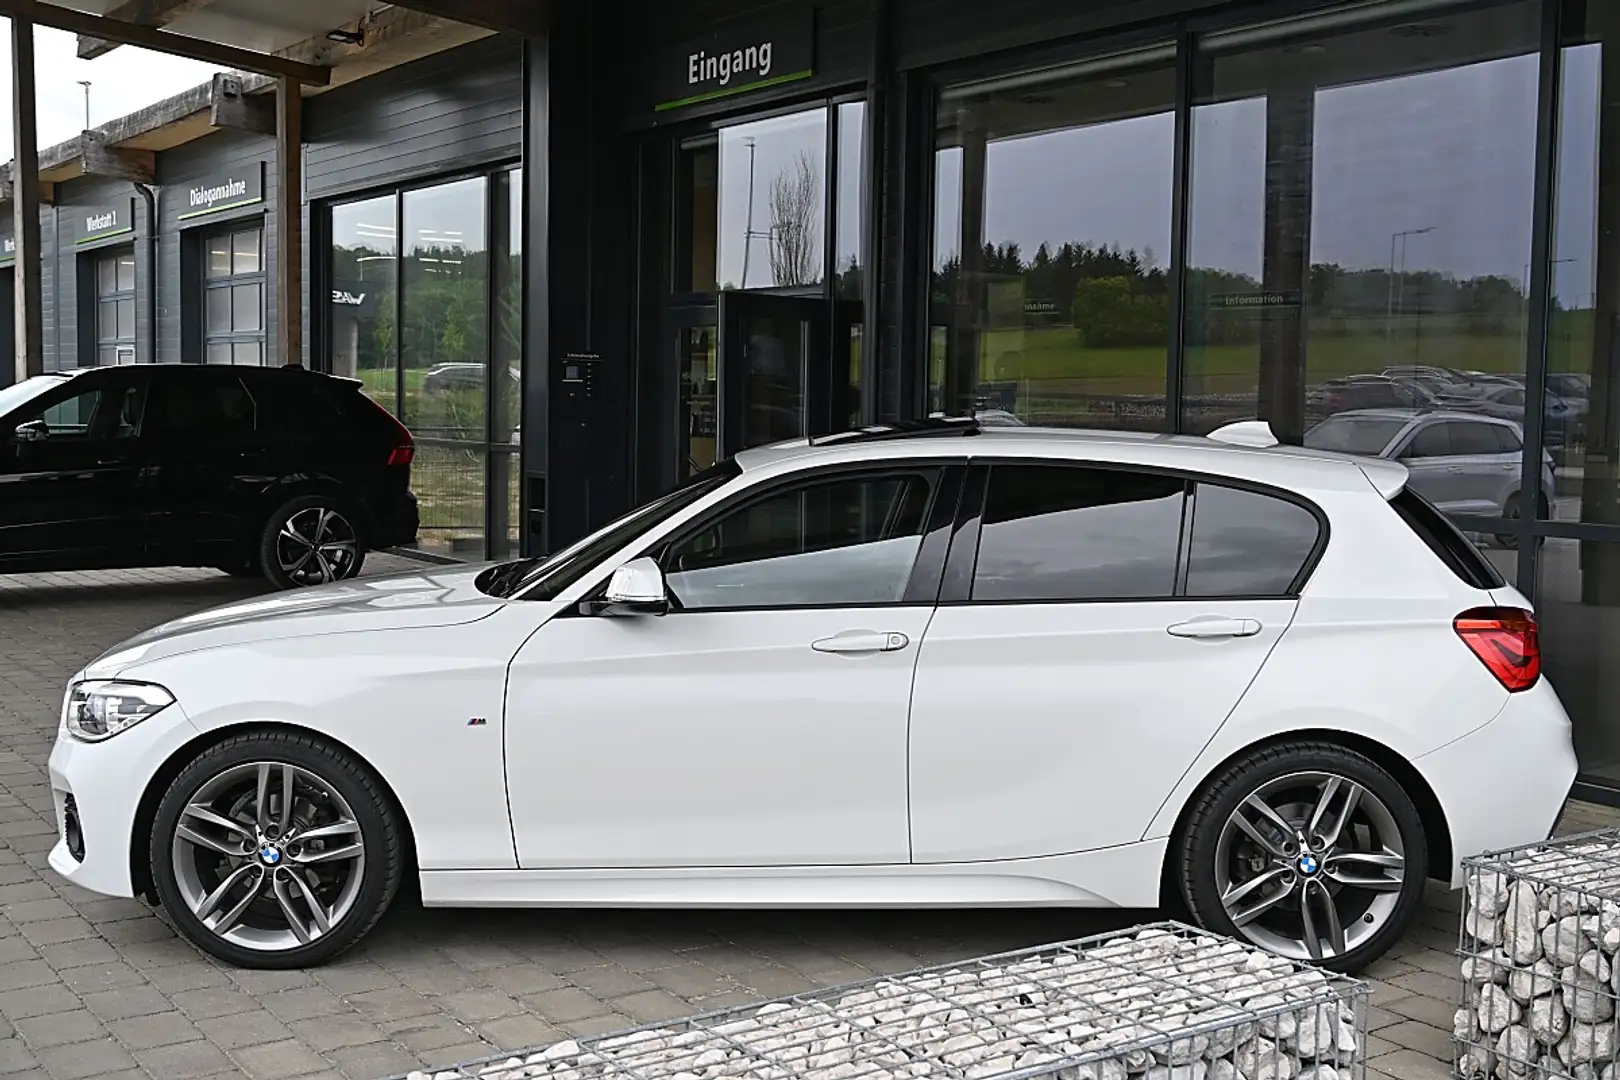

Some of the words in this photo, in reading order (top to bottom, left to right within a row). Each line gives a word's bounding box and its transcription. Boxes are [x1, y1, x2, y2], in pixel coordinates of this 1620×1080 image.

[688, 41, 772, 85] Eingang
[190, 178, 246, 207] Dialogannahme
[1225, 294, 1284, 305] Information
